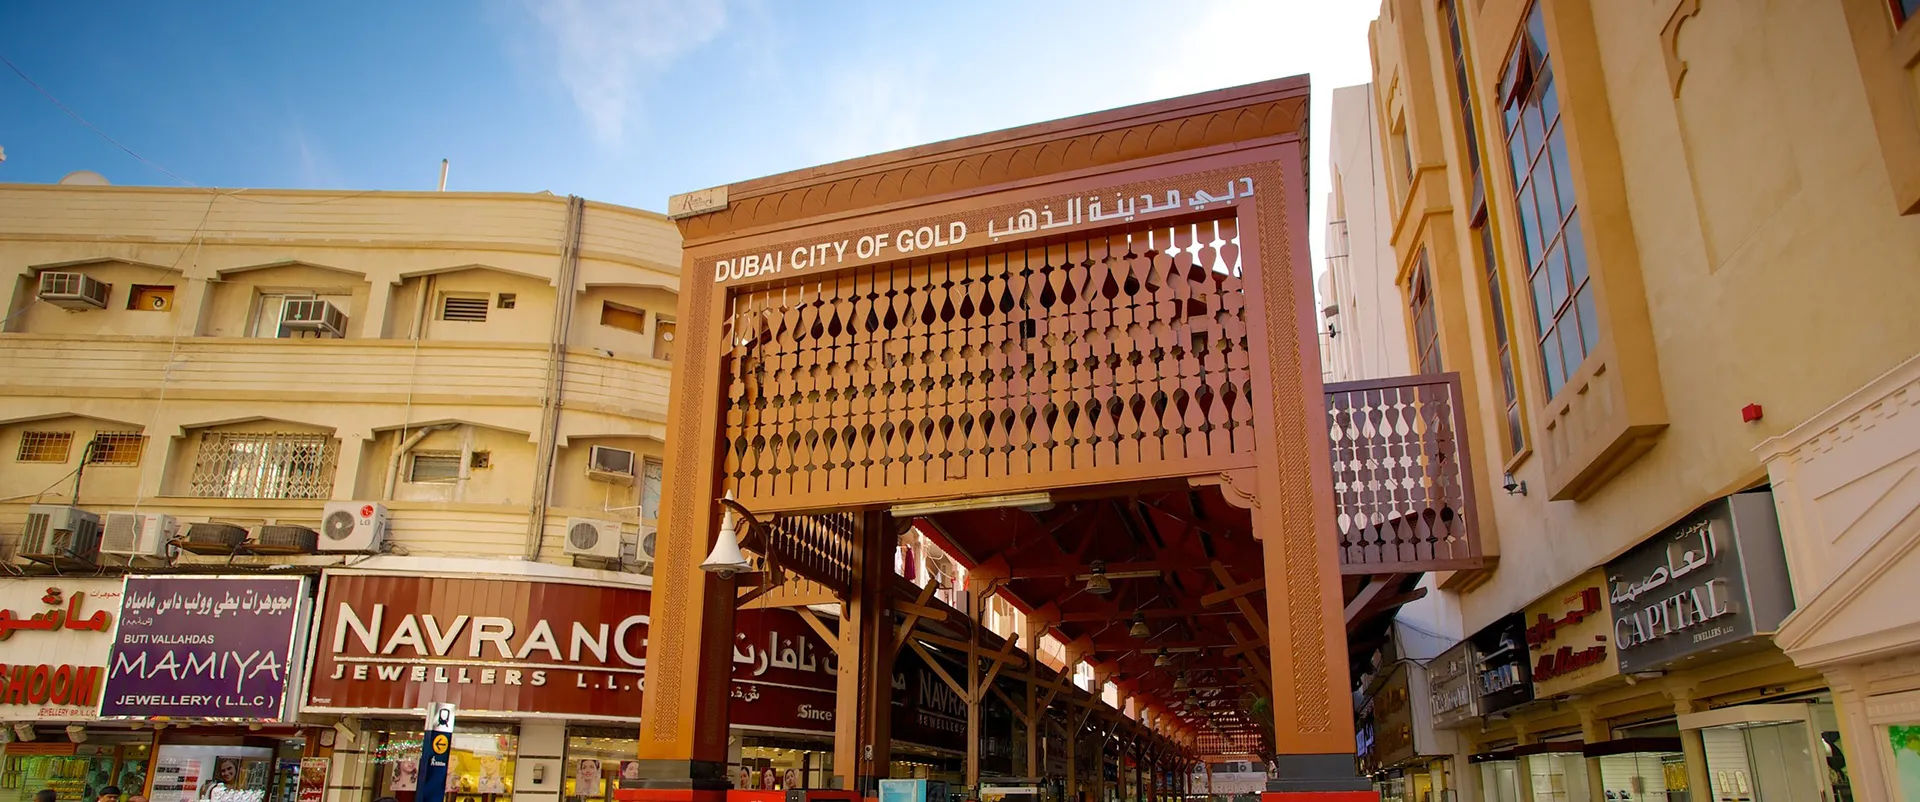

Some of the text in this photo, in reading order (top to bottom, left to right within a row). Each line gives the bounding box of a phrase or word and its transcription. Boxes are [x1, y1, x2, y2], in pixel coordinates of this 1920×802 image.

[988, 177, 1254, 242] دبي مدينة الذهب
[715, 221, 967, 283] DUBAI CITY OF GOLD
[1609, 523, 1717, 604] العاصمة
[213, 590, 240, 618] بطي
[242, 589, 293, 615] مجوهرات
[1615, 579, 1728, 650] CAPITAL
[123, 634, 215, 644] BUTI VALLAHDAS
[1693, 627, 1722, 644] JEWELLERS
[110, 650, 282, 694] MAMIYA
[330, 664, 547, 687] JEWELLERS
[115, 695, 213, 706] JEWELLERY
[920, 668, 968, 718] NAVRA
[797, 704, 833, 721] Since
